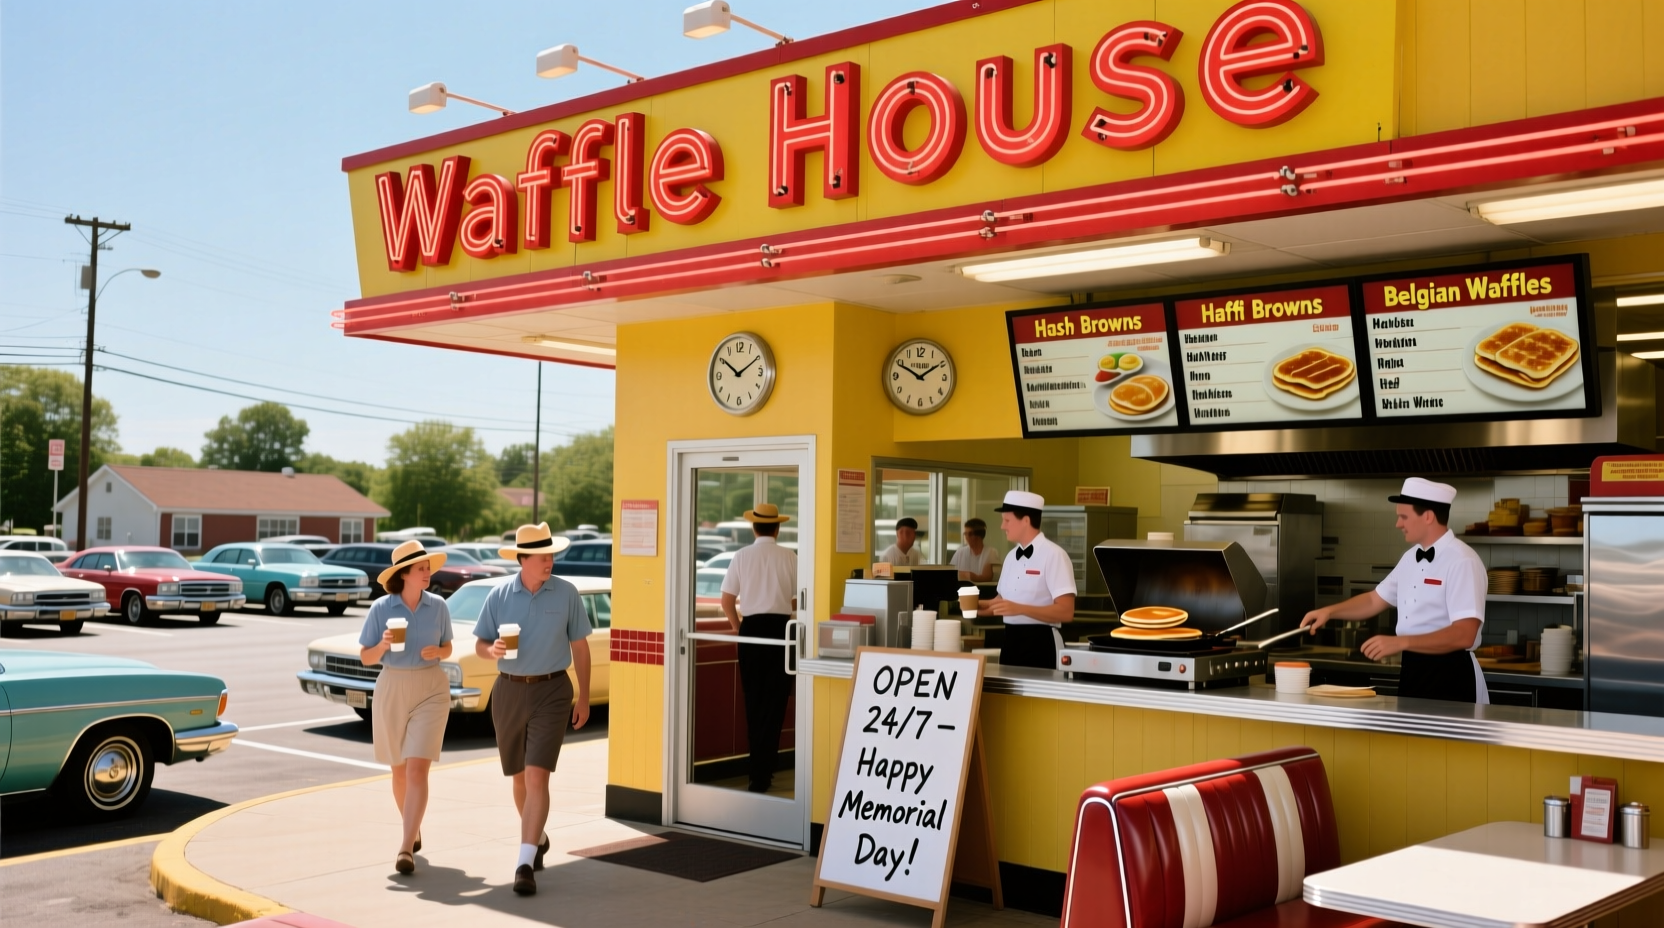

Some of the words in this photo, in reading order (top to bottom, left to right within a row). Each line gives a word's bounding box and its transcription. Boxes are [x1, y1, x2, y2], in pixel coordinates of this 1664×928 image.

[375, 111, 725, 272] Waffle
[768, 0, 1325, 209] House
[1252, 297, 1323, 319] Browns
[1384, 282, 1461, 310] Belgian
[1465, 272, 1553, 300] Waffles
[1034, 315, 1075, 338] Hash
[1080, 315, 1143, 334] Browns
[916, 346, 926, 358] 12
[873, 665, 958, 700] OPEN
[862, 705, 933, 740] 24/7
[856, 746, 934, 795] Happy
[837, 789, 948, 831] Memorial
[854, 833, 920, 882] Day!
